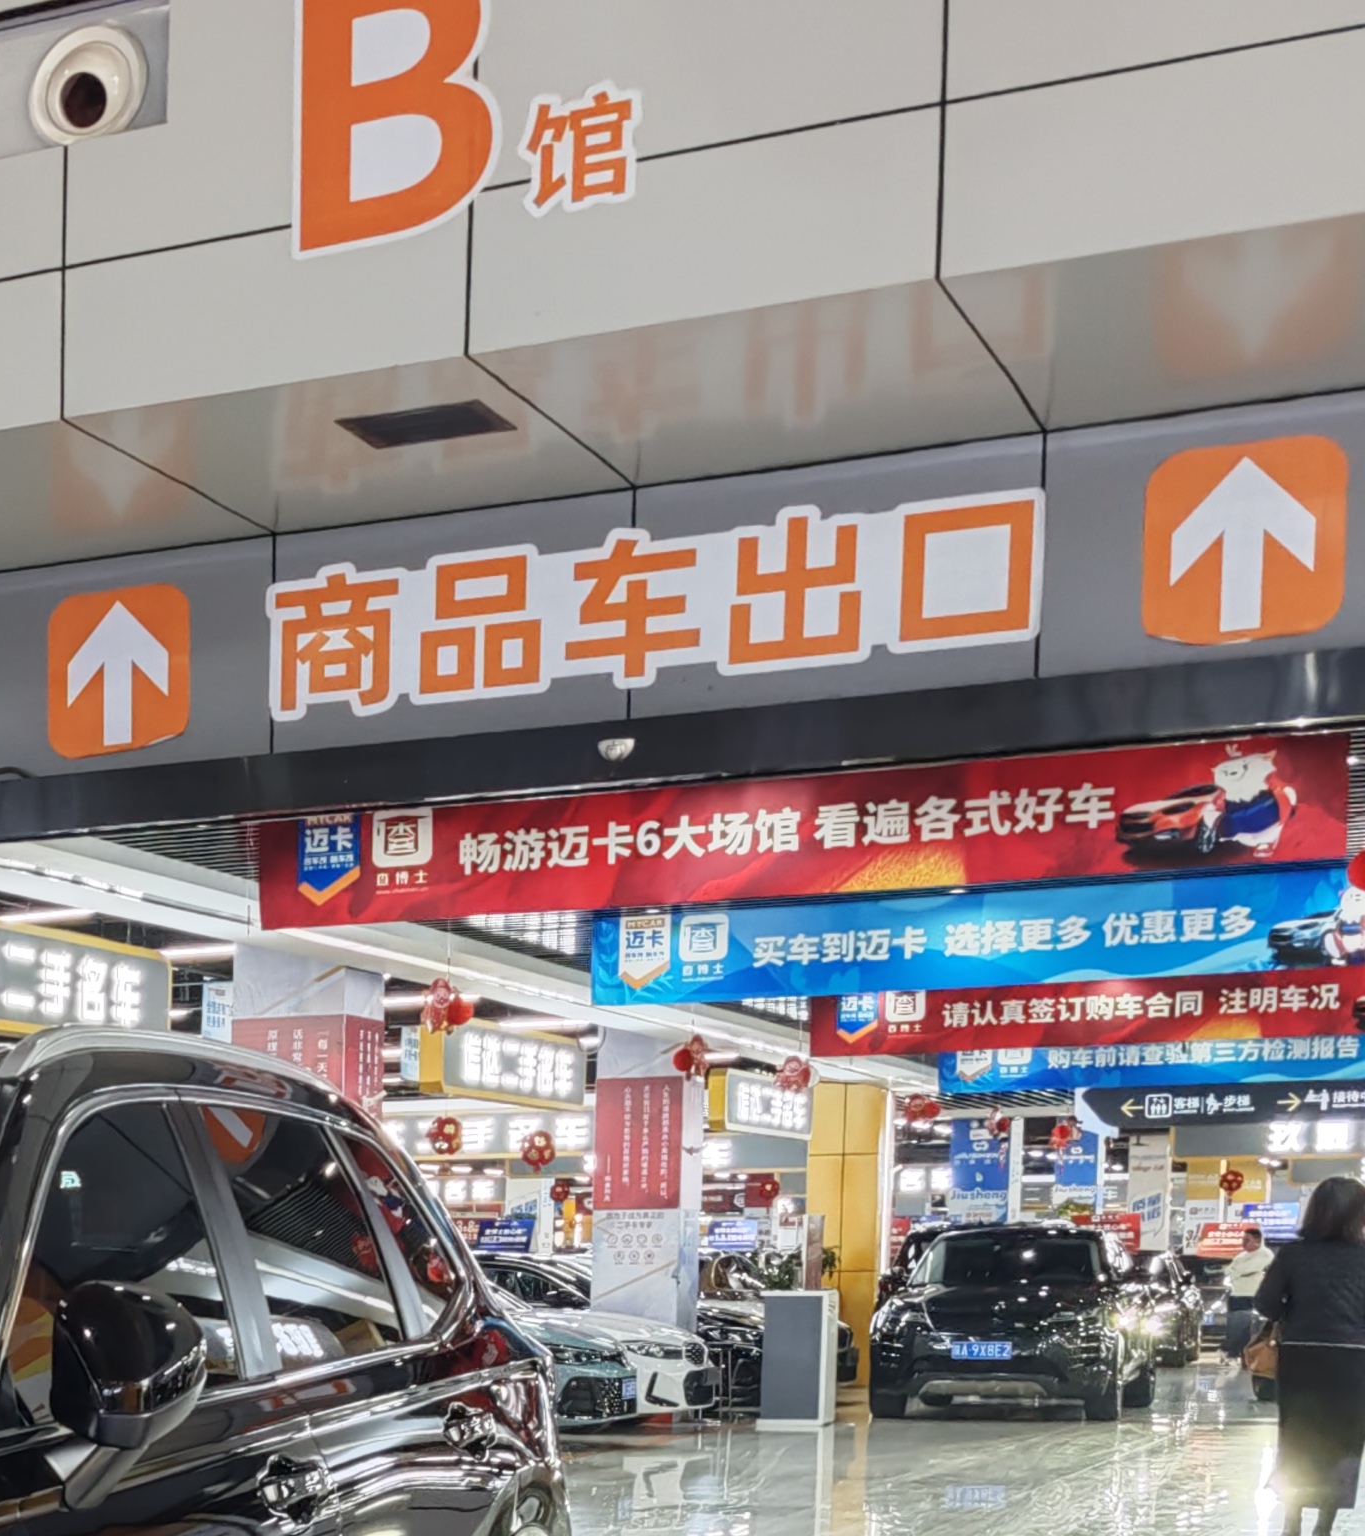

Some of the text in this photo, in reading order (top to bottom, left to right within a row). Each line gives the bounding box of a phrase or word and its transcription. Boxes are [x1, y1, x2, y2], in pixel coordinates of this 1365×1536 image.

[273, 497, 1037, 712] 商品车出口
[304, 826, 355, 854] 迈卡
[459, 782, 1117, 876] 畅游迈卡6大场馆 看遍各式好车
[625, 919, 666, 930] MYCAR
[625, 930, 665, 950] 迈卡
[752, 905, 1257, 968] 买车到迈卡 选择更多 优惠更多
[840, 996, 874, 1012] 迈卡
[941, 983, 1341, 1029] 请认真签订购车合同 注明车况
[1047, 1034, 1361, 1070] 购车前请查验第三方检测报告
